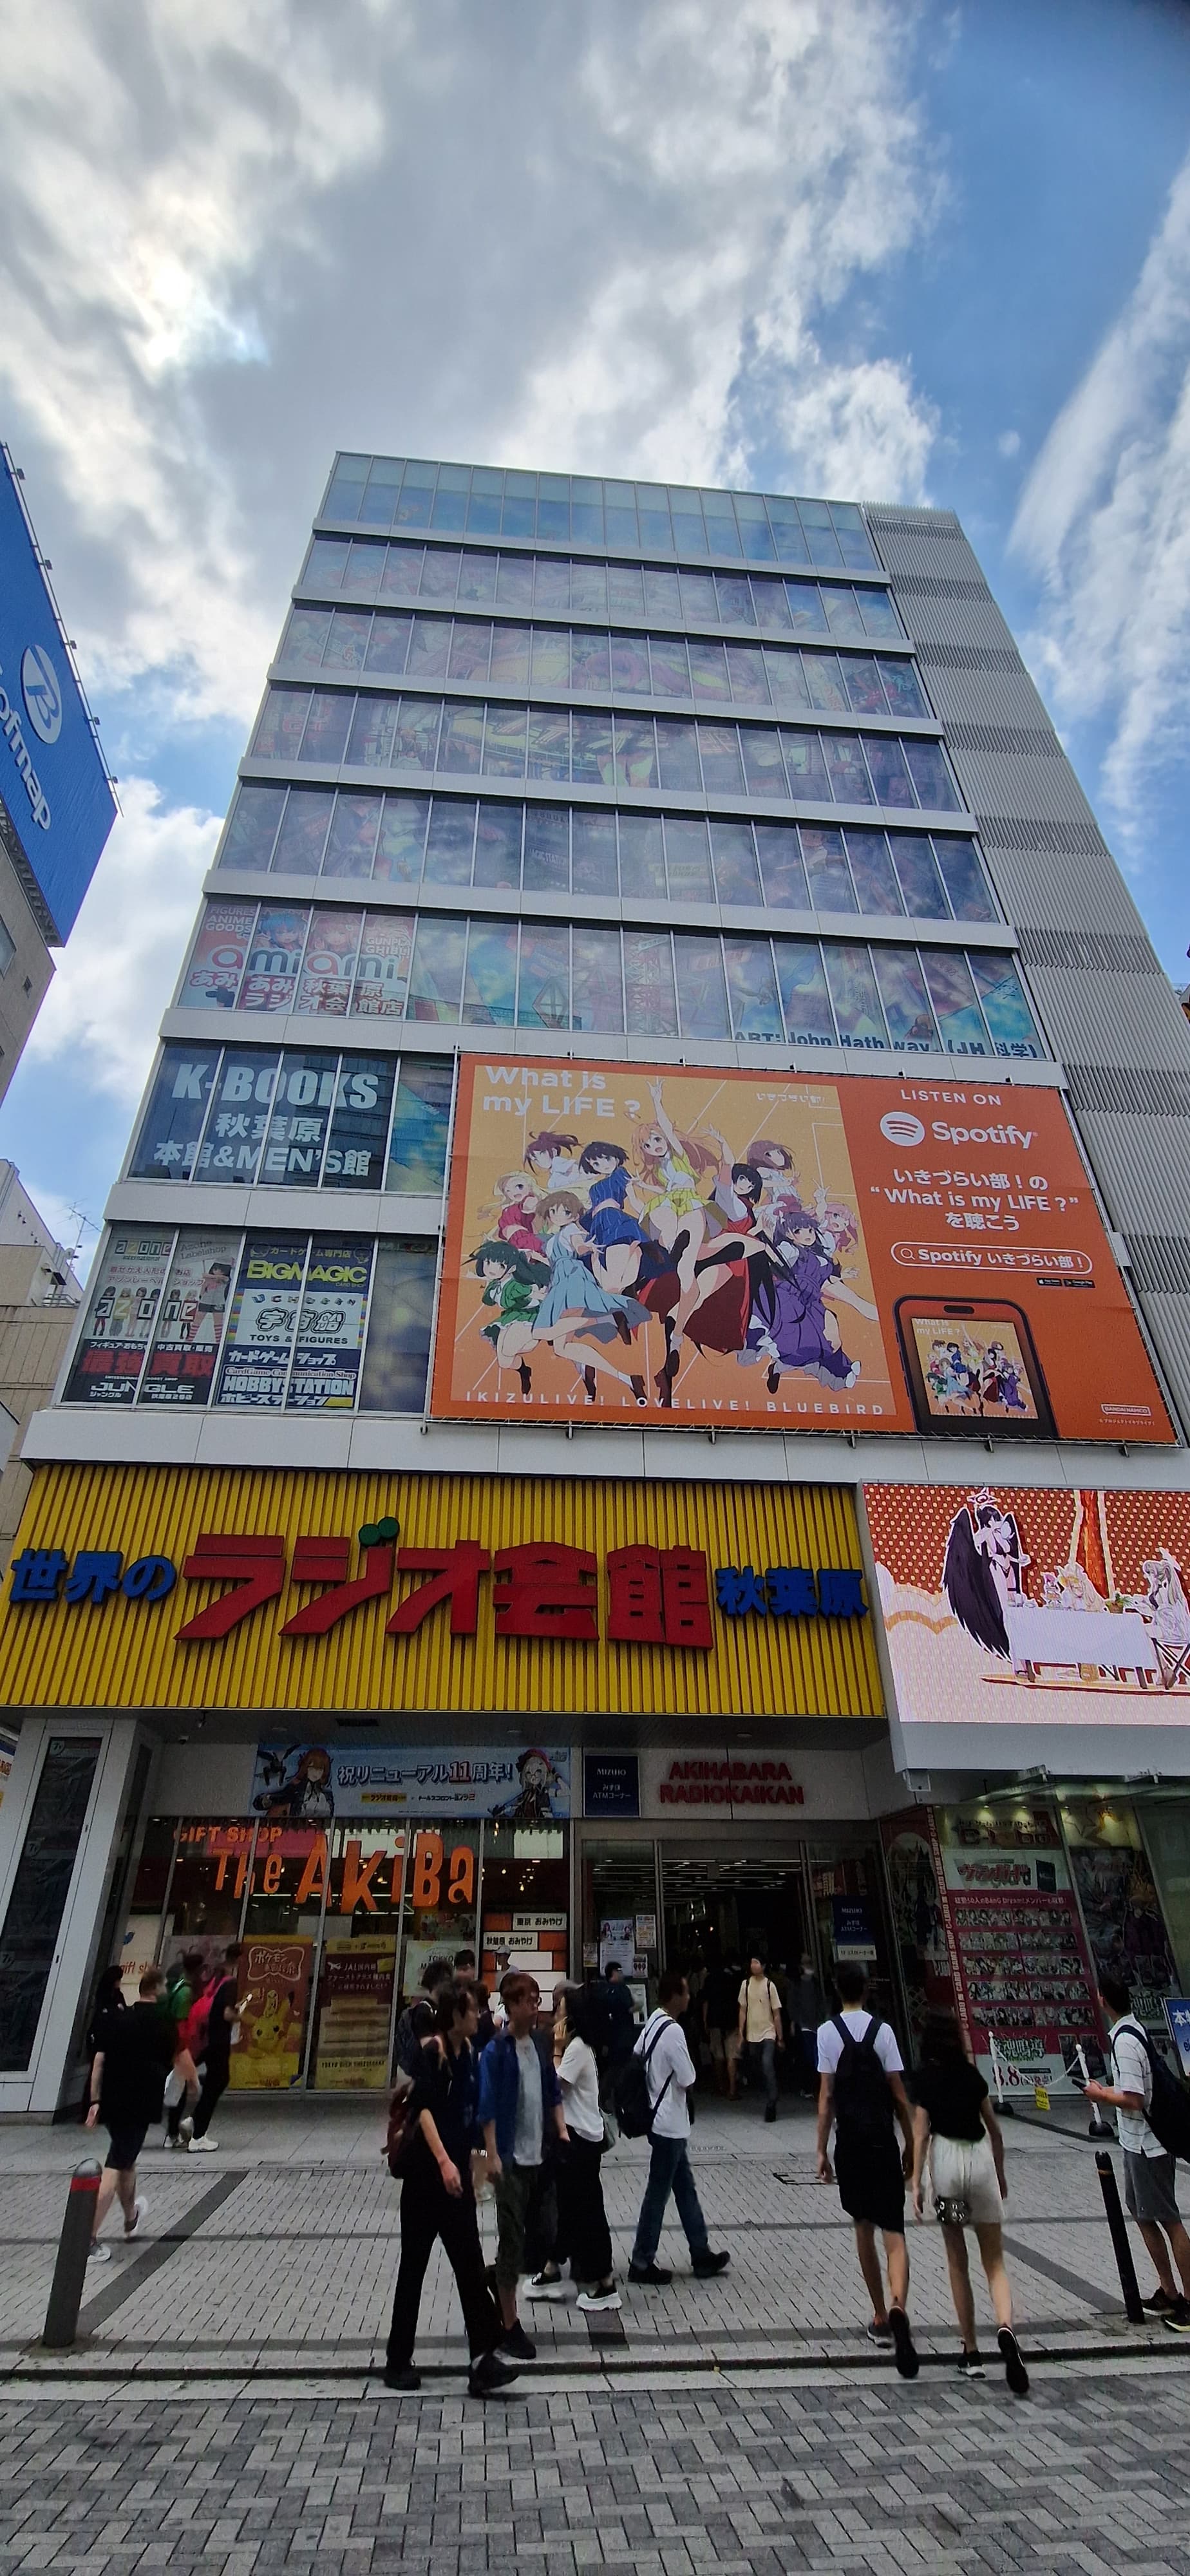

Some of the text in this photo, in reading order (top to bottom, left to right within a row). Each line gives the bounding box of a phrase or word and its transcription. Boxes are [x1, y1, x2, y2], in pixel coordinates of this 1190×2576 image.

[0, 662, 51, 831] ofmap
[210, 906, 256, 916] FIGURES
[205, 922, 252, 933] GOODS
[207, 916, 253, 925] ANIME
[366, 937, 411, 947] GUNPLA
[734, 1031, 782, 1042] ART:
[789, 1031, 832, 1046] John
[172, 1063, 379, 1110] K-BOOKS
[486, 1067, 607, 1090] What is
[901, 1089, 1002, 1106] LISTEN ON
[483, 1095, 641, 1119] my LIFE ?
[214, 1113, 324, 1143] 秋葉原
[893, 1168, 1048, 1191] いきづらい部！の
[948, 1191, 965, 1207] is
[971, 1197, 1001, 1212] my
[1007, 1197, 1051, 1211] LIFE
[945, 1213, 1021, 1231] を聴こう
[115, 1240, 173, 1256] azone
[918, 1249, 1084, 1269] Spotify いきづらい部！
[247, 1260, 368, 1283] BIGMAGIC
[299, 1336, 348, 1345] FIGURES
[229, 1350, 337, 1366] カードゲームショップ
[335, 1371, 356, 1379] Shop
[91, 1381, 195, 1395] JUNGLE
[466, 1390, 883, 1416] IKIZULIVE! LOVELIVE! BLUEBIRD
[10, 1516, 869, 1650] 世界の ラジオ会館 秋葉原
[596, 1768, 627, 1777] MIZUHO
[668, 1761, 793, 1781] AKIHABARA
[659, 1785, 805, 1804] RADIOKAIKAN
[173, 1827, 282, 1843] GIFT SHOP
[211, 1847, 283, 1899] The
[534, 1917, 563, 1926] おみやげ
[508, 1936, 533, 1946] おみやげ
[254, 1949, 288, 1964] ポケモン
